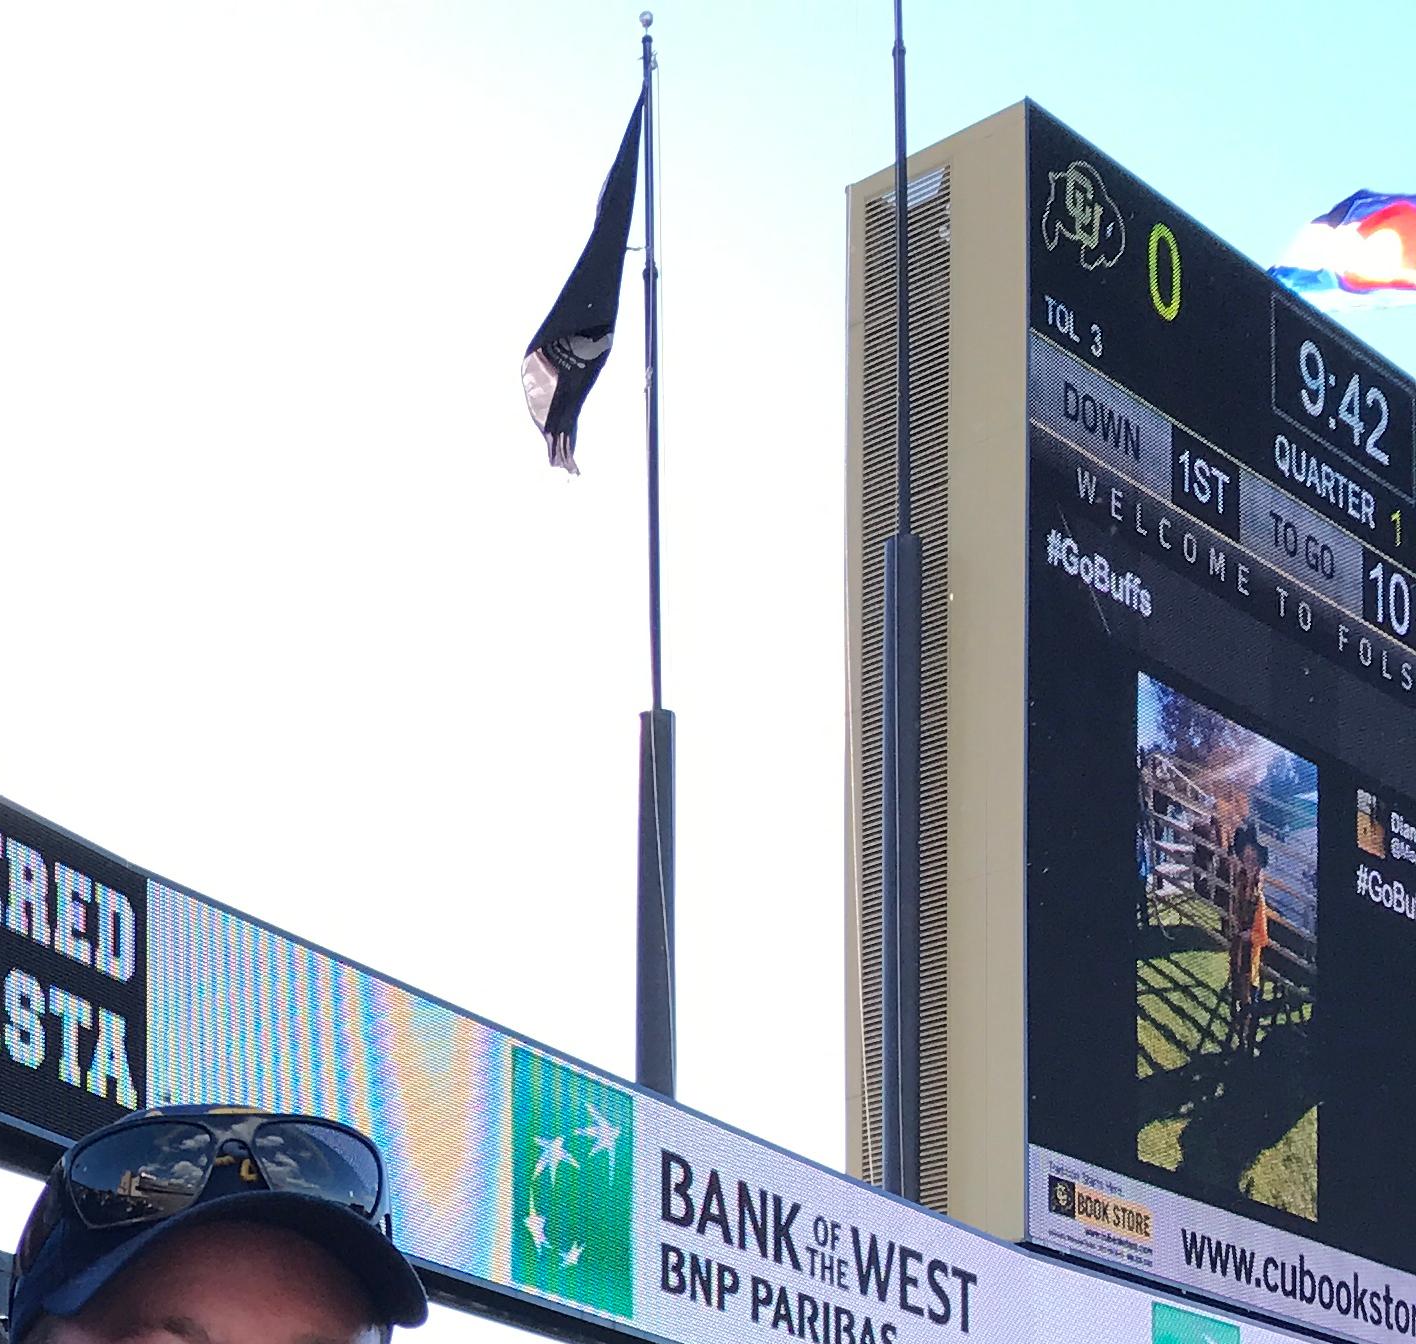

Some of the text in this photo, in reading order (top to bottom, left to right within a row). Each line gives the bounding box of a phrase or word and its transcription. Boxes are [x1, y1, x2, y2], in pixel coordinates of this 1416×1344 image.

[1148, 222, 1182, 322] 0
[1045, 294, 1103, 358] TOL 3
[1299, 339, 1391, 467] 9:42
[1063, 381, 1411, 636] DOWN 1ST TO GO 10
[1274, 434, 1402, 547] QUARTER 1
[1046, 529, 1153, 618] #GoBuffs
[1076, 466, 1250, 596] WELCOME
[1276, 586, 1312, 632] TO
[661, 1149, 803, 1272] BANK
[813, 1215, 841, 1251] OF
[1077, 1192, 1151, 1238] BOOK STORE
[661, 1242, 739, 1312] BNP
[805, 1246, 849, 1291] THE
[850, 1224, 977, 1334] WEST
